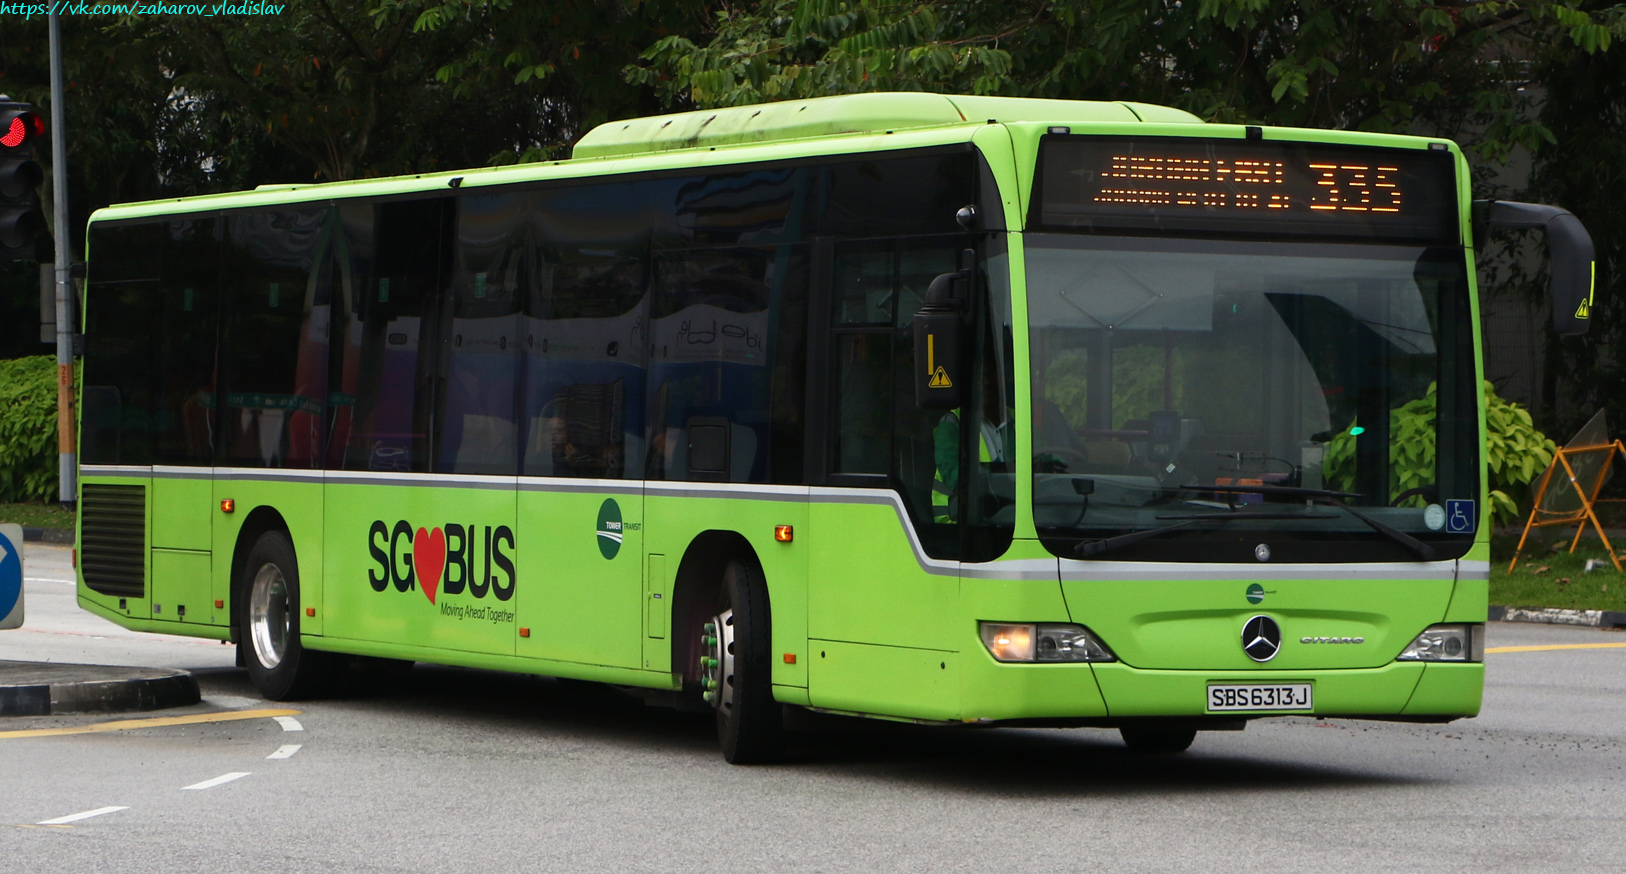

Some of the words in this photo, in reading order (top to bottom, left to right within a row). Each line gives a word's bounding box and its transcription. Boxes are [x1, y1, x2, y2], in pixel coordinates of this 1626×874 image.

[1309, 163, 1401, 212] 335
[606, 521, 622, 530] TOWER
[623, 522, 642, 531] TRANSIT
[440, 602, 464, 621] Moving
[464, 604, 486, 620] Ahead
[486, 606, 515, 625] Together
[1300, 636, 1364, 644] CITARO
